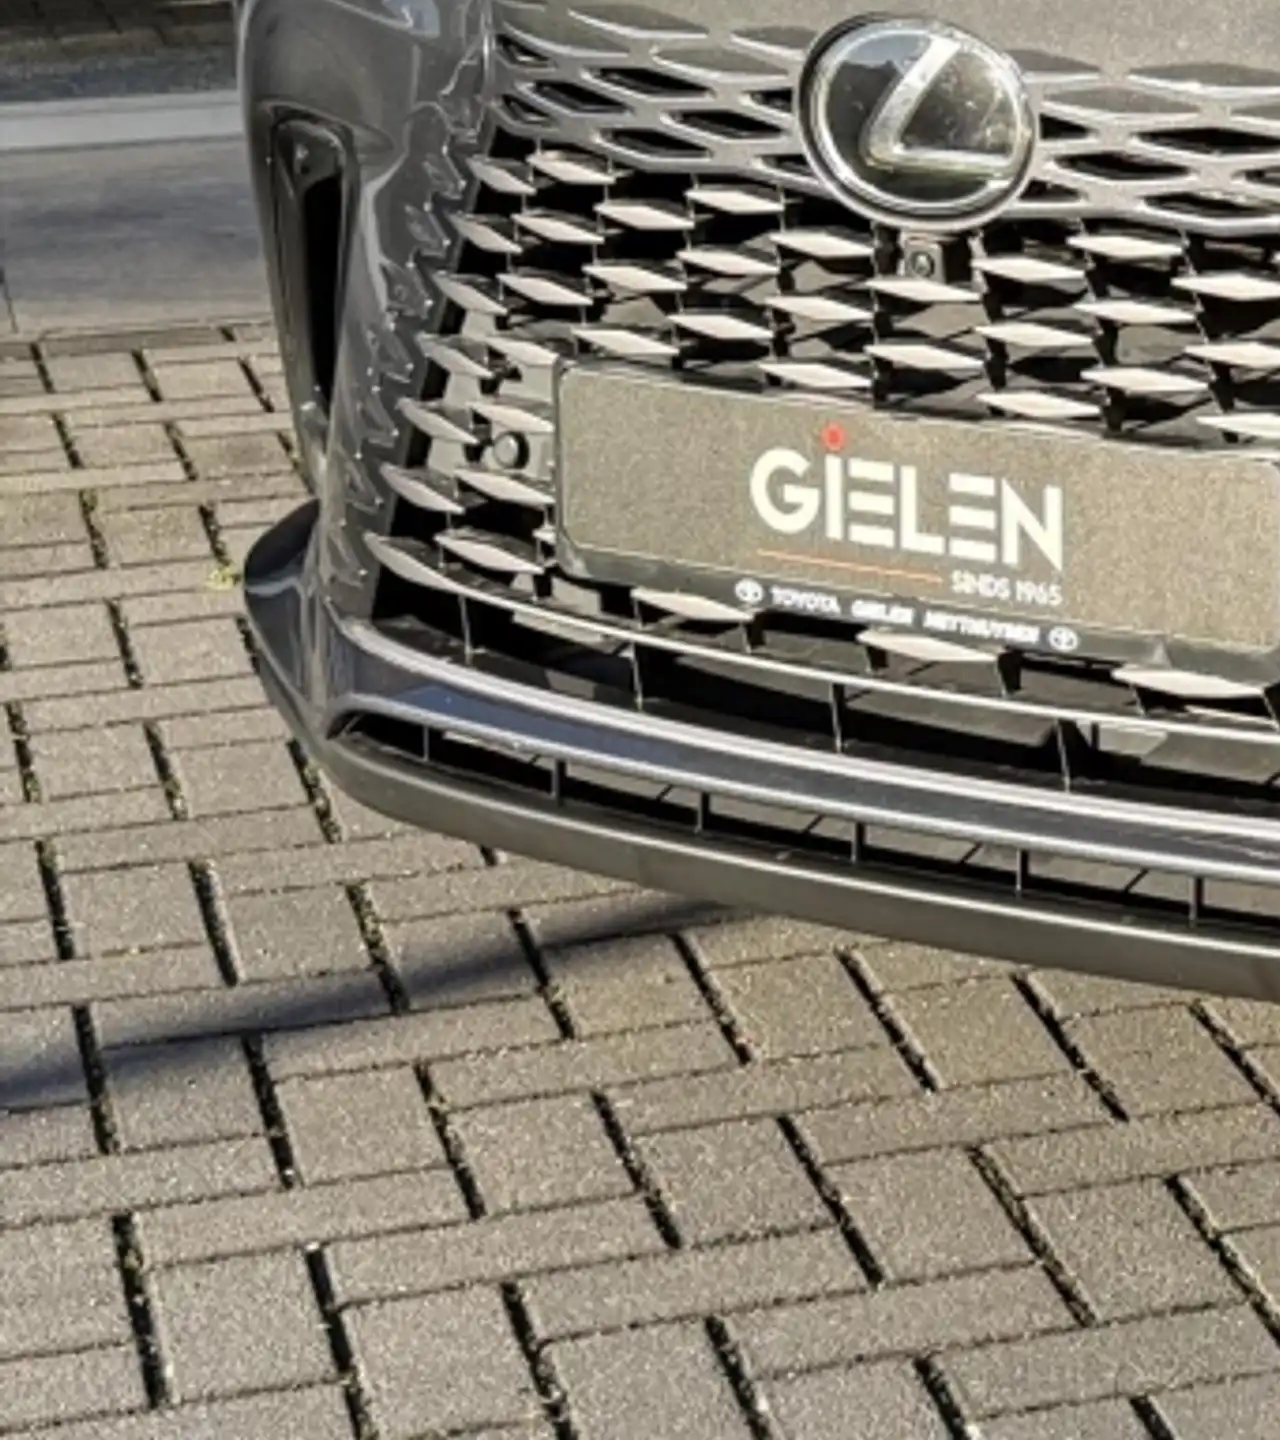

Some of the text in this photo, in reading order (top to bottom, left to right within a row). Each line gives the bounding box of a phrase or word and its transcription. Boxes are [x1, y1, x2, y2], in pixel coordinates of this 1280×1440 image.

[769, 585, 842, 615] TOYOTA
[951, 568, 1064, 607] SINDS 1965
